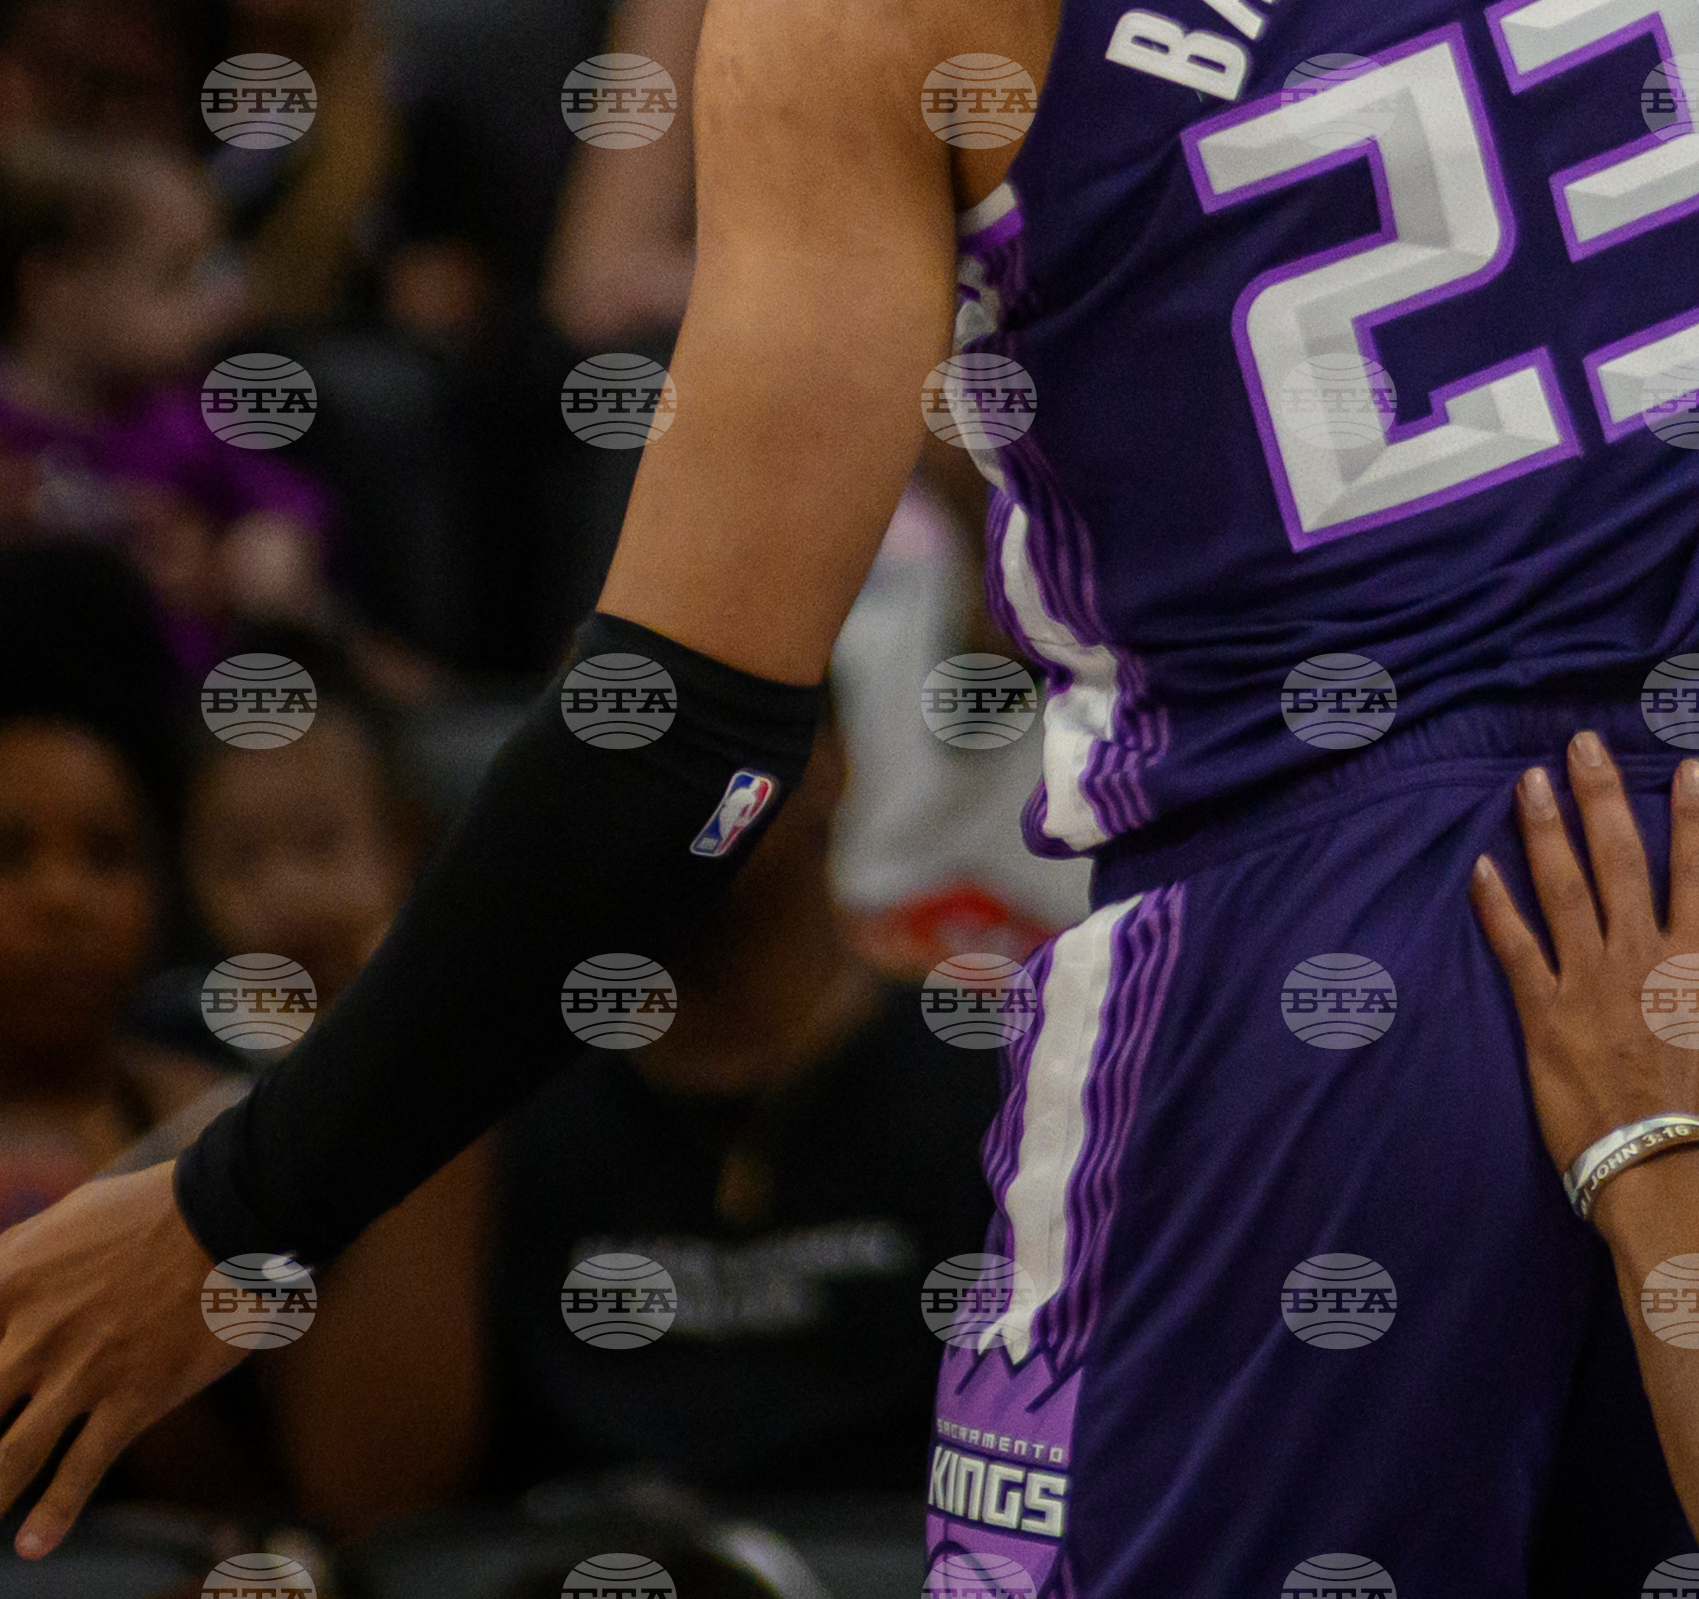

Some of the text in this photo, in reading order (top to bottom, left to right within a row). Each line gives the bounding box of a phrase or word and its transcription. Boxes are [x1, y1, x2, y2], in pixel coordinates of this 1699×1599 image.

[1589, 1124, 1692, 1191] JOHN 3:16
[936, 1418, 1065, 1463] SACRAMENTO
[928, 1444, 1067, 1538] KINGS
